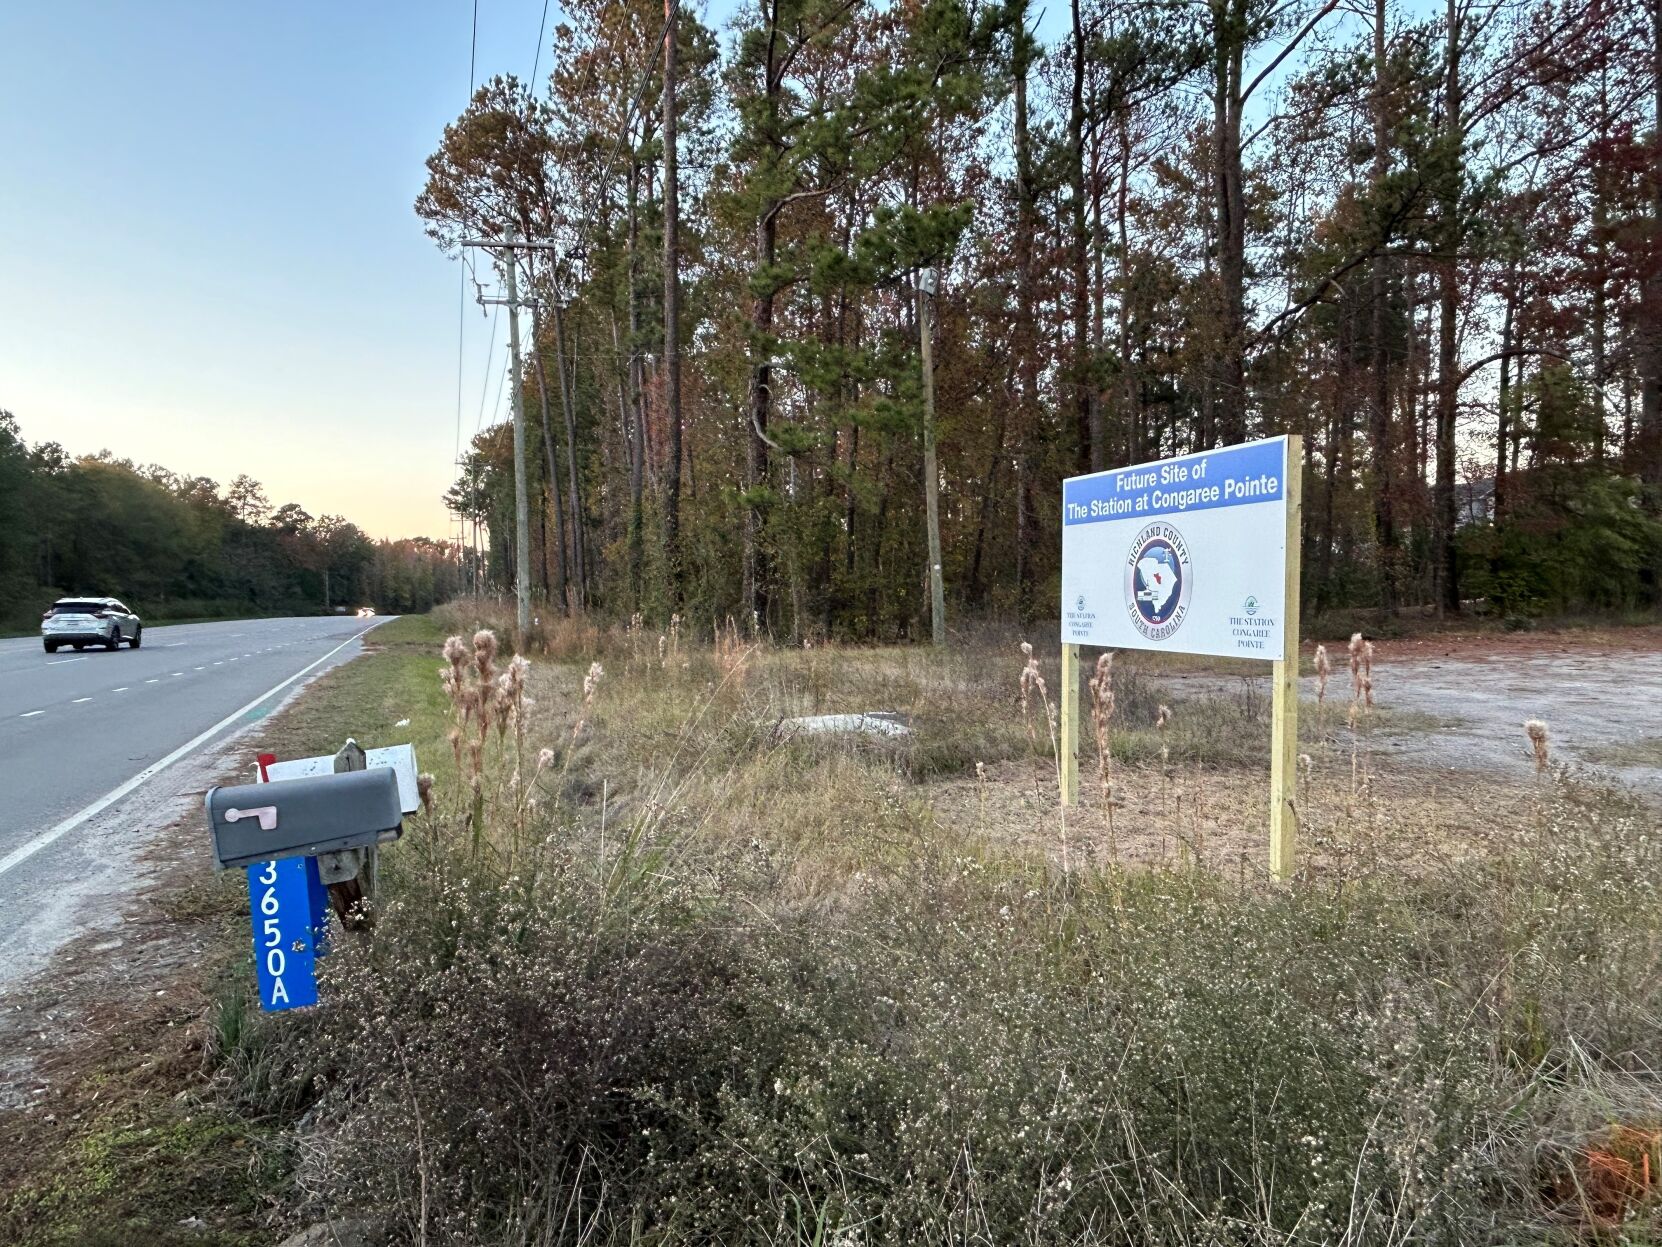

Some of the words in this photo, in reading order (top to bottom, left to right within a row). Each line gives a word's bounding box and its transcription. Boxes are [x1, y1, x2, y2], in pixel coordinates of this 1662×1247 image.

[1116, 472, 1157, 492] Future
[1160, 465, 1188, 485] Site
[1191, 459, 1208, 478] of
[1067, 503, 1088, 519] The
[1090, 497, 1132, 517] Station
[1135, 493, 1149, 511] at
[1152, 484, 1220, 510] Congaree
[1224, 475, 1278, 499] Pointe
[1163, 527, 1189, 565] COUNTY
[1150, 605, 1186, 639] CAROLINA
[1244, 617, 1274, 626] STATION
[259, 860, 290, 1004] 3650A
